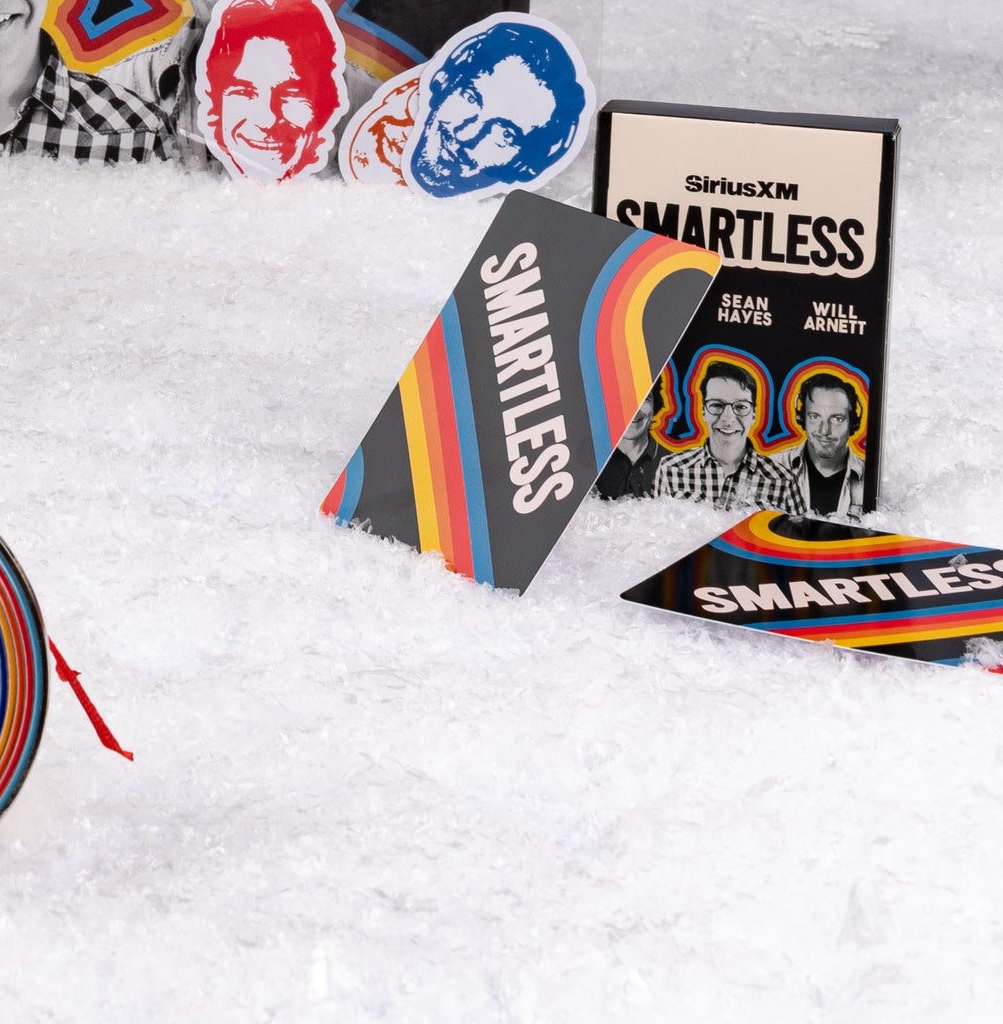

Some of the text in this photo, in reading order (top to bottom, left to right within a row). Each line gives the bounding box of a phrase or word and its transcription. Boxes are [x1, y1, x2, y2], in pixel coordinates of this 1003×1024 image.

[684, 174, 799, 201] SiriusXM
[721, 293, 769, 311] SEAN
[812, 301, 858, 320] WILL
[717, 308, 772, 326] HAYES
[803, 316, 867, 335] ARNETT
[480, 242, 574, 515] SMARTLESS
[693, 559, 1003, 614] SMARTLES
